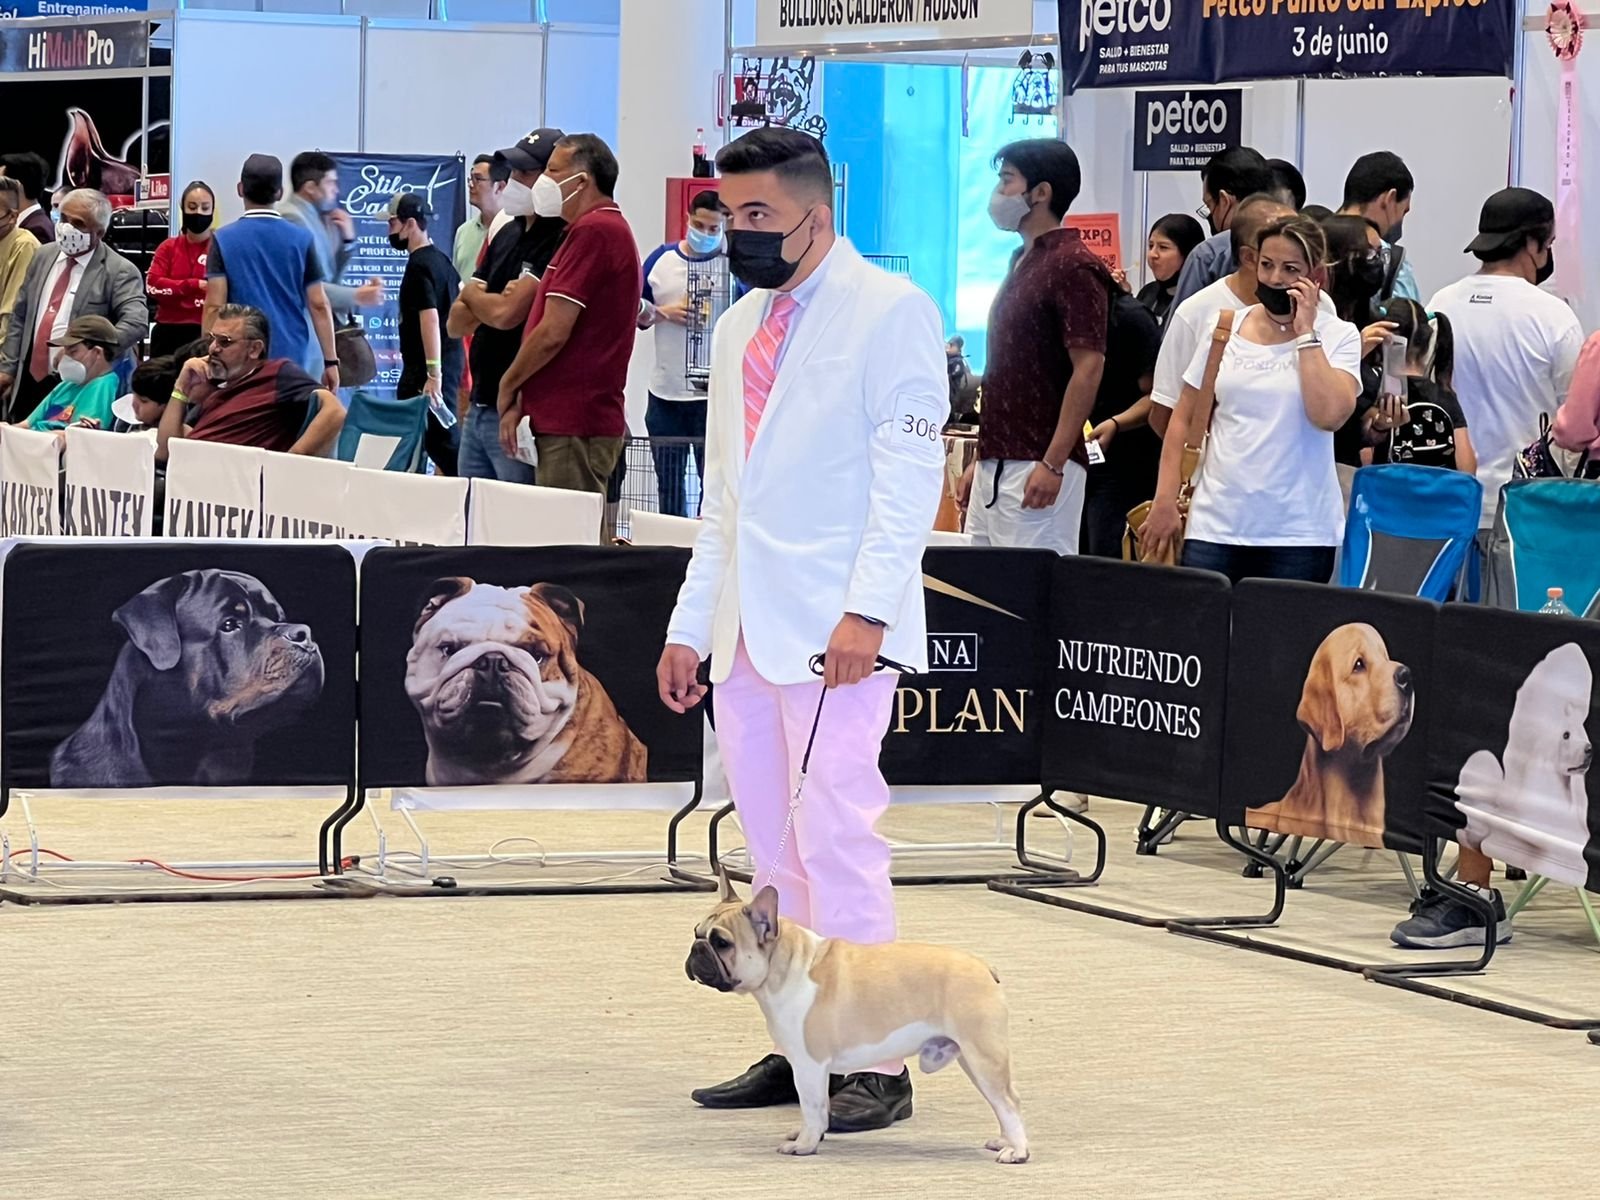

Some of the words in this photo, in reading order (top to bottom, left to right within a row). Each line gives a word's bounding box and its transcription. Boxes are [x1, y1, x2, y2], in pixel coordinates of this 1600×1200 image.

[38, 1, 137, 15] Entrenamiento
[779, 0, 843, 27] BULLDOGS
[846, 0, 913, 25] CALDERON
[922, 0, 978, 21] HUDSON
[1080, 0, 1172, 52] petco
[1099, 46, 1122, 58] SALUD
[1129, 43, 1169, 56] BIENESTAR
[1292, 27, 1305, 56] 3
[1310, 26, 1332, 56] de
[1335, 23, 1389, 62] junio
[1099, 64, 1115, 74] PARA
[1116, 62, 1129, 73] TUS
[1129, 60, 1168, 72] MASCOTAS
[1147, 92, 1227, 146] petco
[1170, 143, 1190, 153] SALUD
[1169, 157, 1184, 166] PARA
[151, 180, 168, 197] Like
[1080, 228, 1112, 246] XPO
[359, 247, 409, 257] PROFESIO
[902, 414, 937, 442] 306
[1058, 639, 1201, 688] NUTRIENDO
[893, 687, 1029, 734] PLAN
[1055, 688, 1201, 739] CAMPEONES
